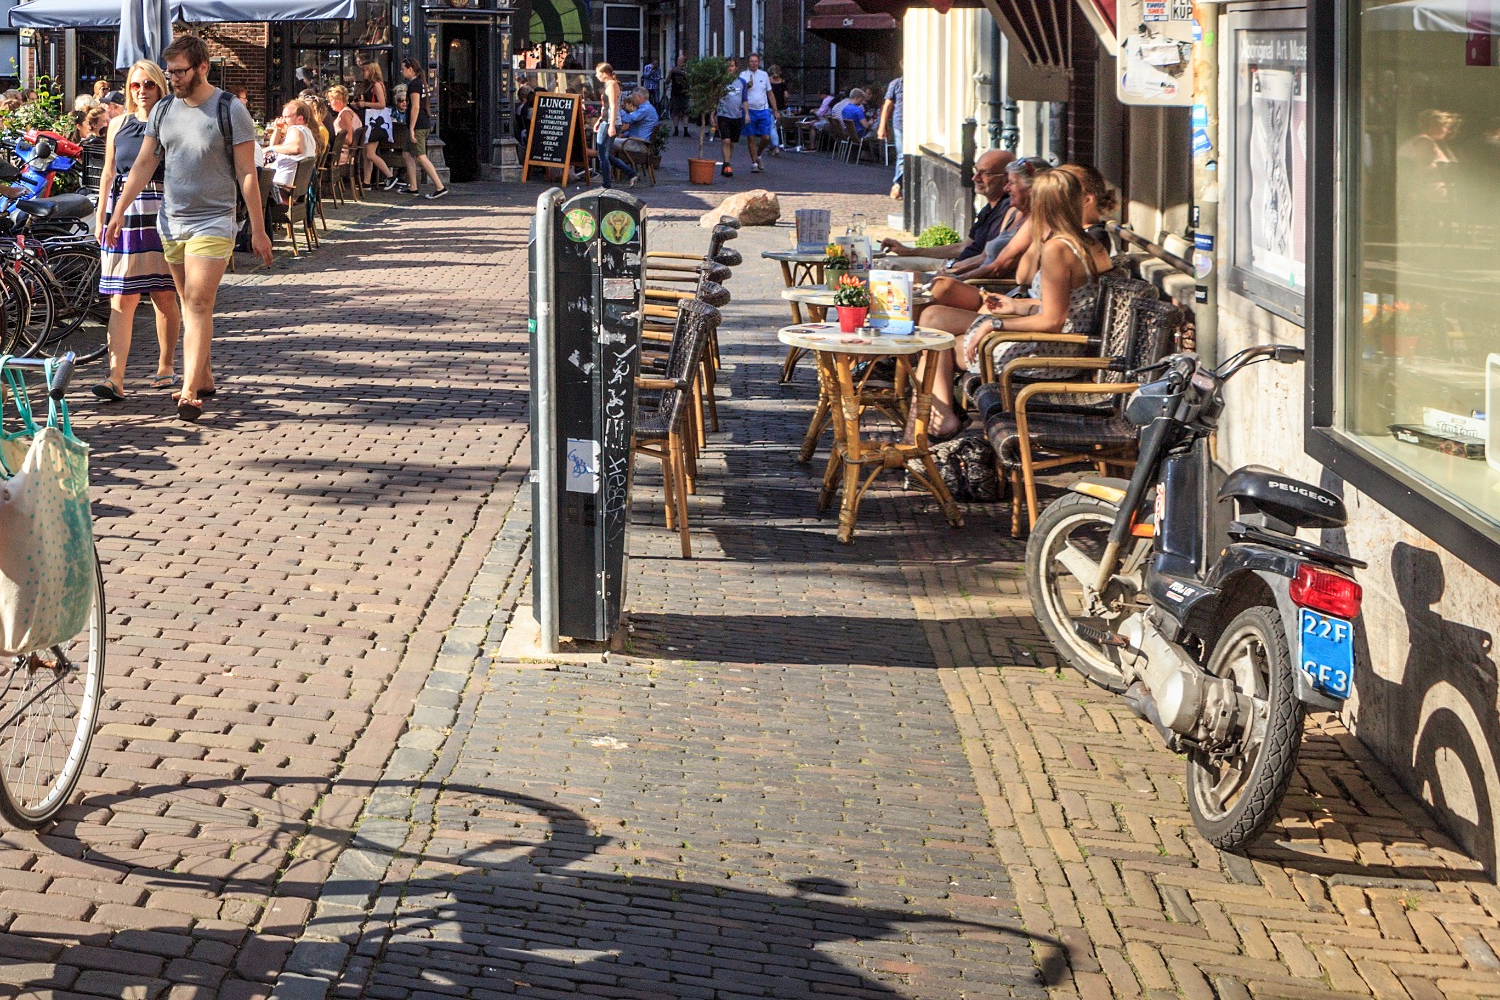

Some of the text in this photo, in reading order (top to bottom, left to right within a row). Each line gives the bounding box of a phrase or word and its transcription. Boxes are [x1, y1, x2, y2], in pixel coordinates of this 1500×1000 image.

[1276, 39, 1288, 60] Art
[539, 97, 573, 110] LUNCH
[1268, 480, 1337, 508] PEUGEOT
[1304, 614, 1349, 645] 22F
